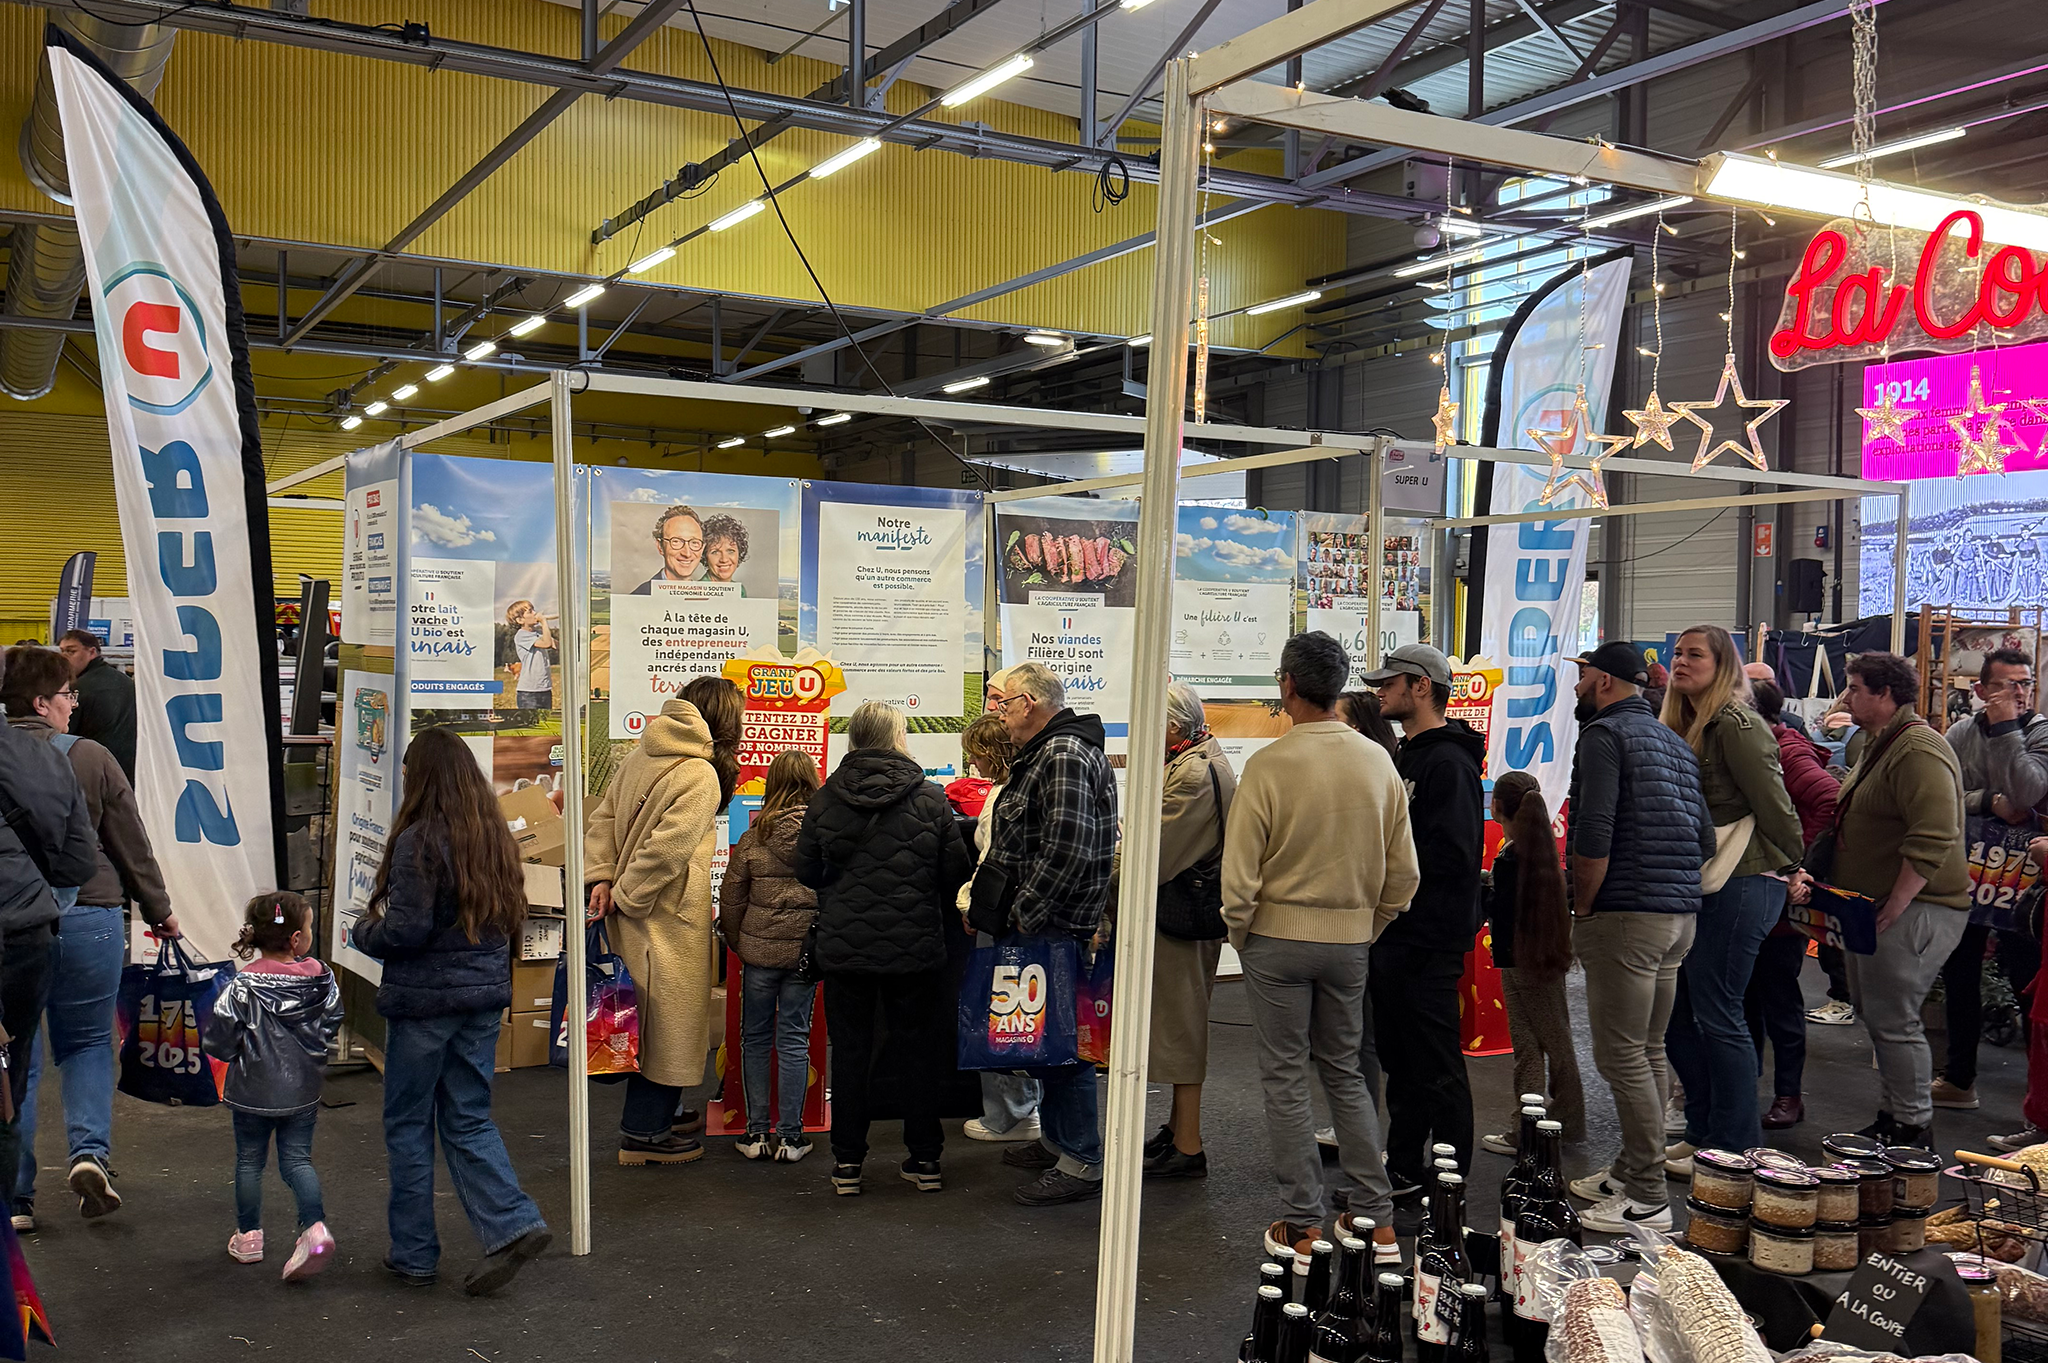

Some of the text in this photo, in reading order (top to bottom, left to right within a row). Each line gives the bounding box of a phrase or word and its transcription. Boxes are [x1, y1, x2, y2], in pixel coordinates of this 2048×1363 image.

[1771, 210, 2048, 358] La Co
[1873, 377, 1931, 407] 1914
[1395, 475, 1429, 486] SUPER U
[877, 517, 911, 529] Notre
[857, 526, 932, 549] manifeste
[857, 565, 875, 574] Chez
[902, 568, 931, 576] pensons
[855, 574, 876, 582] qu'un
[896, 575, 932, 583] commerce
[67, 588, 78, 631] NDARMERIE
[411, 604, 458, 614] otre lait
[412, 616, 448, 625] vache
[663, 610, 729, 624] À la tête de
[1184, 613, 1198, 621] Une
[1200, 609, 1232, 627] filière
[1242, 615, 1258, 623] c'est
[446, 628, 465, 638] est
[640, 625, 750, 638] chaque magasin U,
[1505, 497, 1576, 770] SUPER
[641, 637, 748, 650] des entrepreneurs
[1031, 632, 1102, 645] Nos viandes
[1354, 630, 1397, 651] 600
[411, 639, 477, 658] nçais
[655, 649, 736, 661] indépendants
[1027, 646, 1104, 659] Filière U sont
[647, 662, 717, 673] ancrés dans
[752, 667, 797, 678] GRAND
[1063, 674, 1107, 693] çaise
[1453, 674, 1471, 683] AND
[411, 682, 485, 691] ODUITS ENGAGÉS
[751, 677, 815, 696] JEU U
[1450, 681, 1482, 698] EU U
[908, 698, 917, 706] U
[745, 712, 818, 725] TENTEZ DE
[1446, 708, 1486, 717] ENTEZ DE
[628, 717, 642, 730] U
[744, 726, 817, 741] GAGNER
[738, 742, 824, 754] DE NOMBREUX
[736, 752, 823, 768] CADX
[989, 963, 1047, 1014] 50
[139, 994, 197, 1028] 175
[1096, 1004, 1105, 1014] U
[996, 1015, 1035, 1033] ANS
[995, 1036, 1026, 1044] MAGASINS
[1872, 1284, 1896, 1300] OU
[1836, 1291, 1850, 1309] A
[1850, 1299, 1868, 1320] LA
